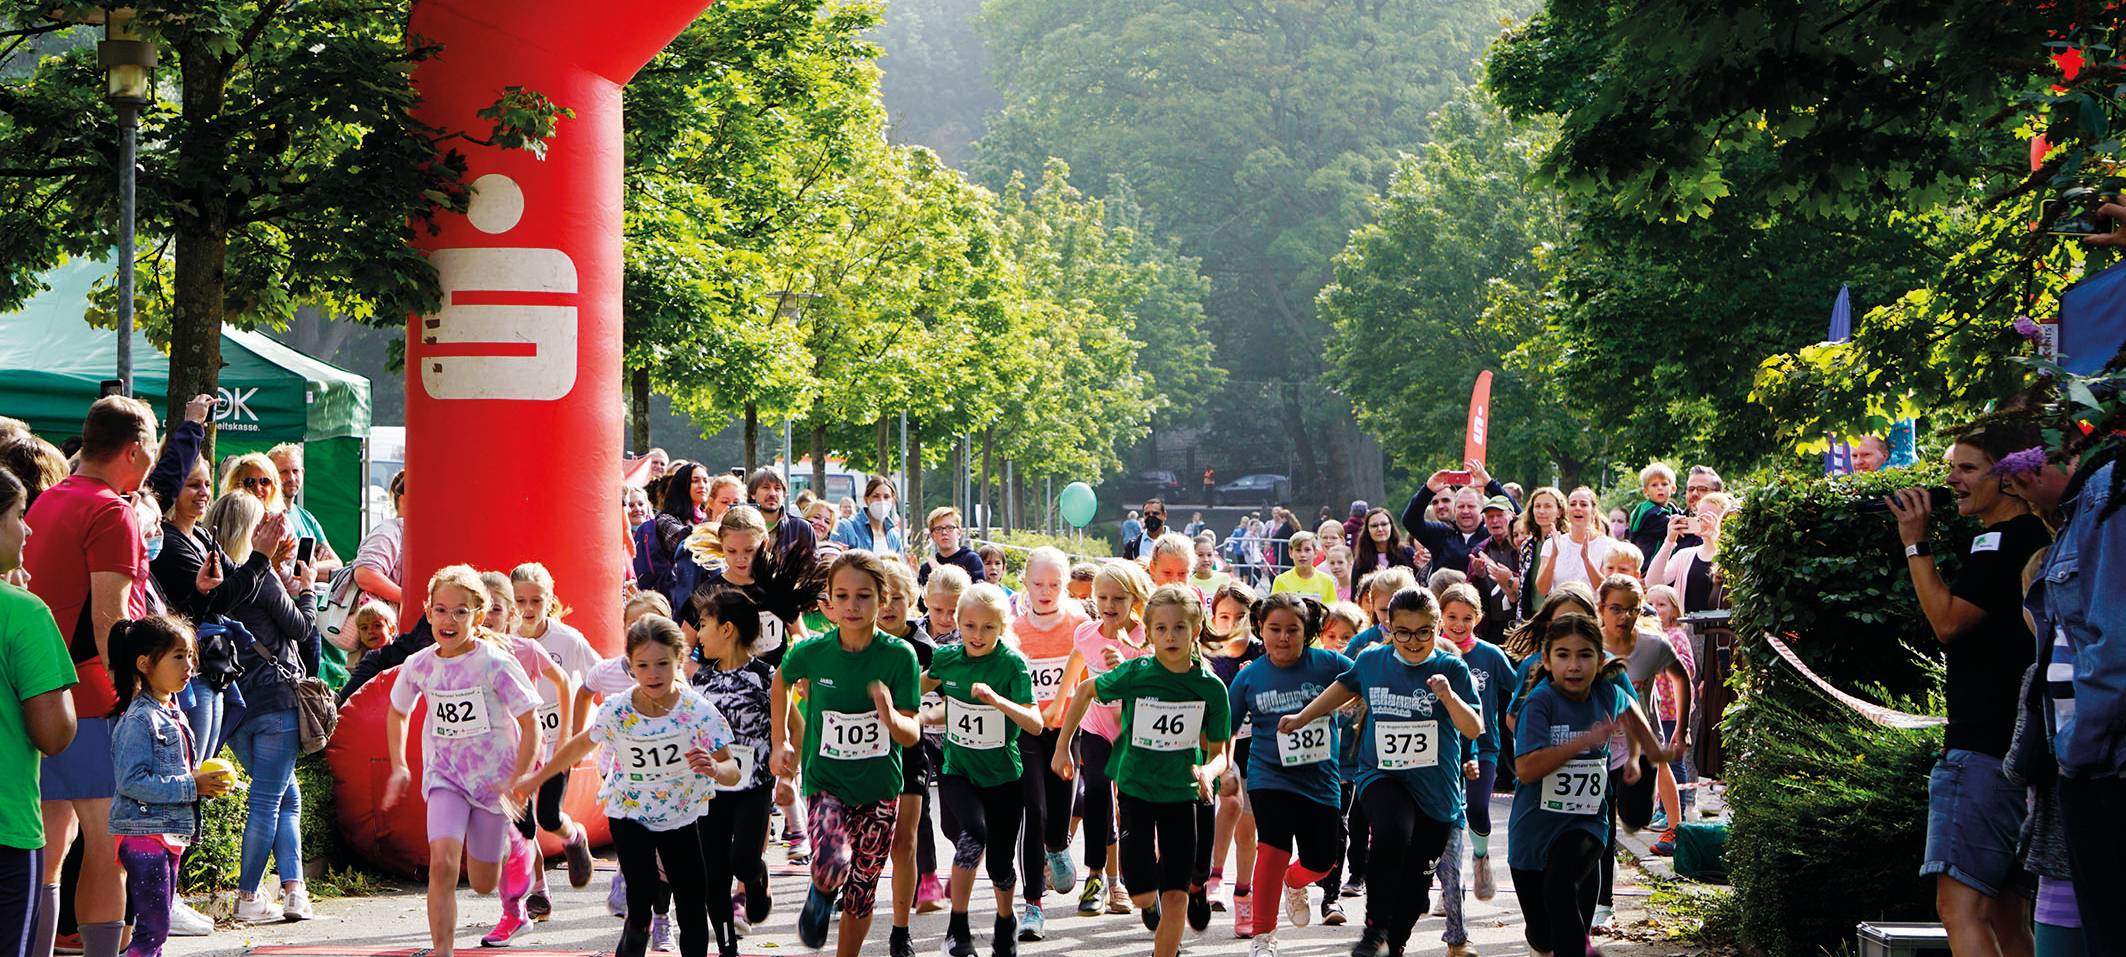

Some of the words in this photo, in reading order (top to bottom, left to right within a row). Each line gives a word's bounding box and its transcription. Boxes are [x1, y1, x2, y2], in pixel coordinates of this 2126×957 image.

[1031, 667, 1064, 687] 462
[436, 701, 476, 723] 482
[834, 722, 879, 745] 103
[958, 714, 983, 735] 41
[1152, 714, 1184, 735] 46
[1287, 728, 1325, 750] 382
[1384, 733, 1428, 754] 373
[630, 744, 681, 768] 312
[1554, 773, 1602, 797] 378
